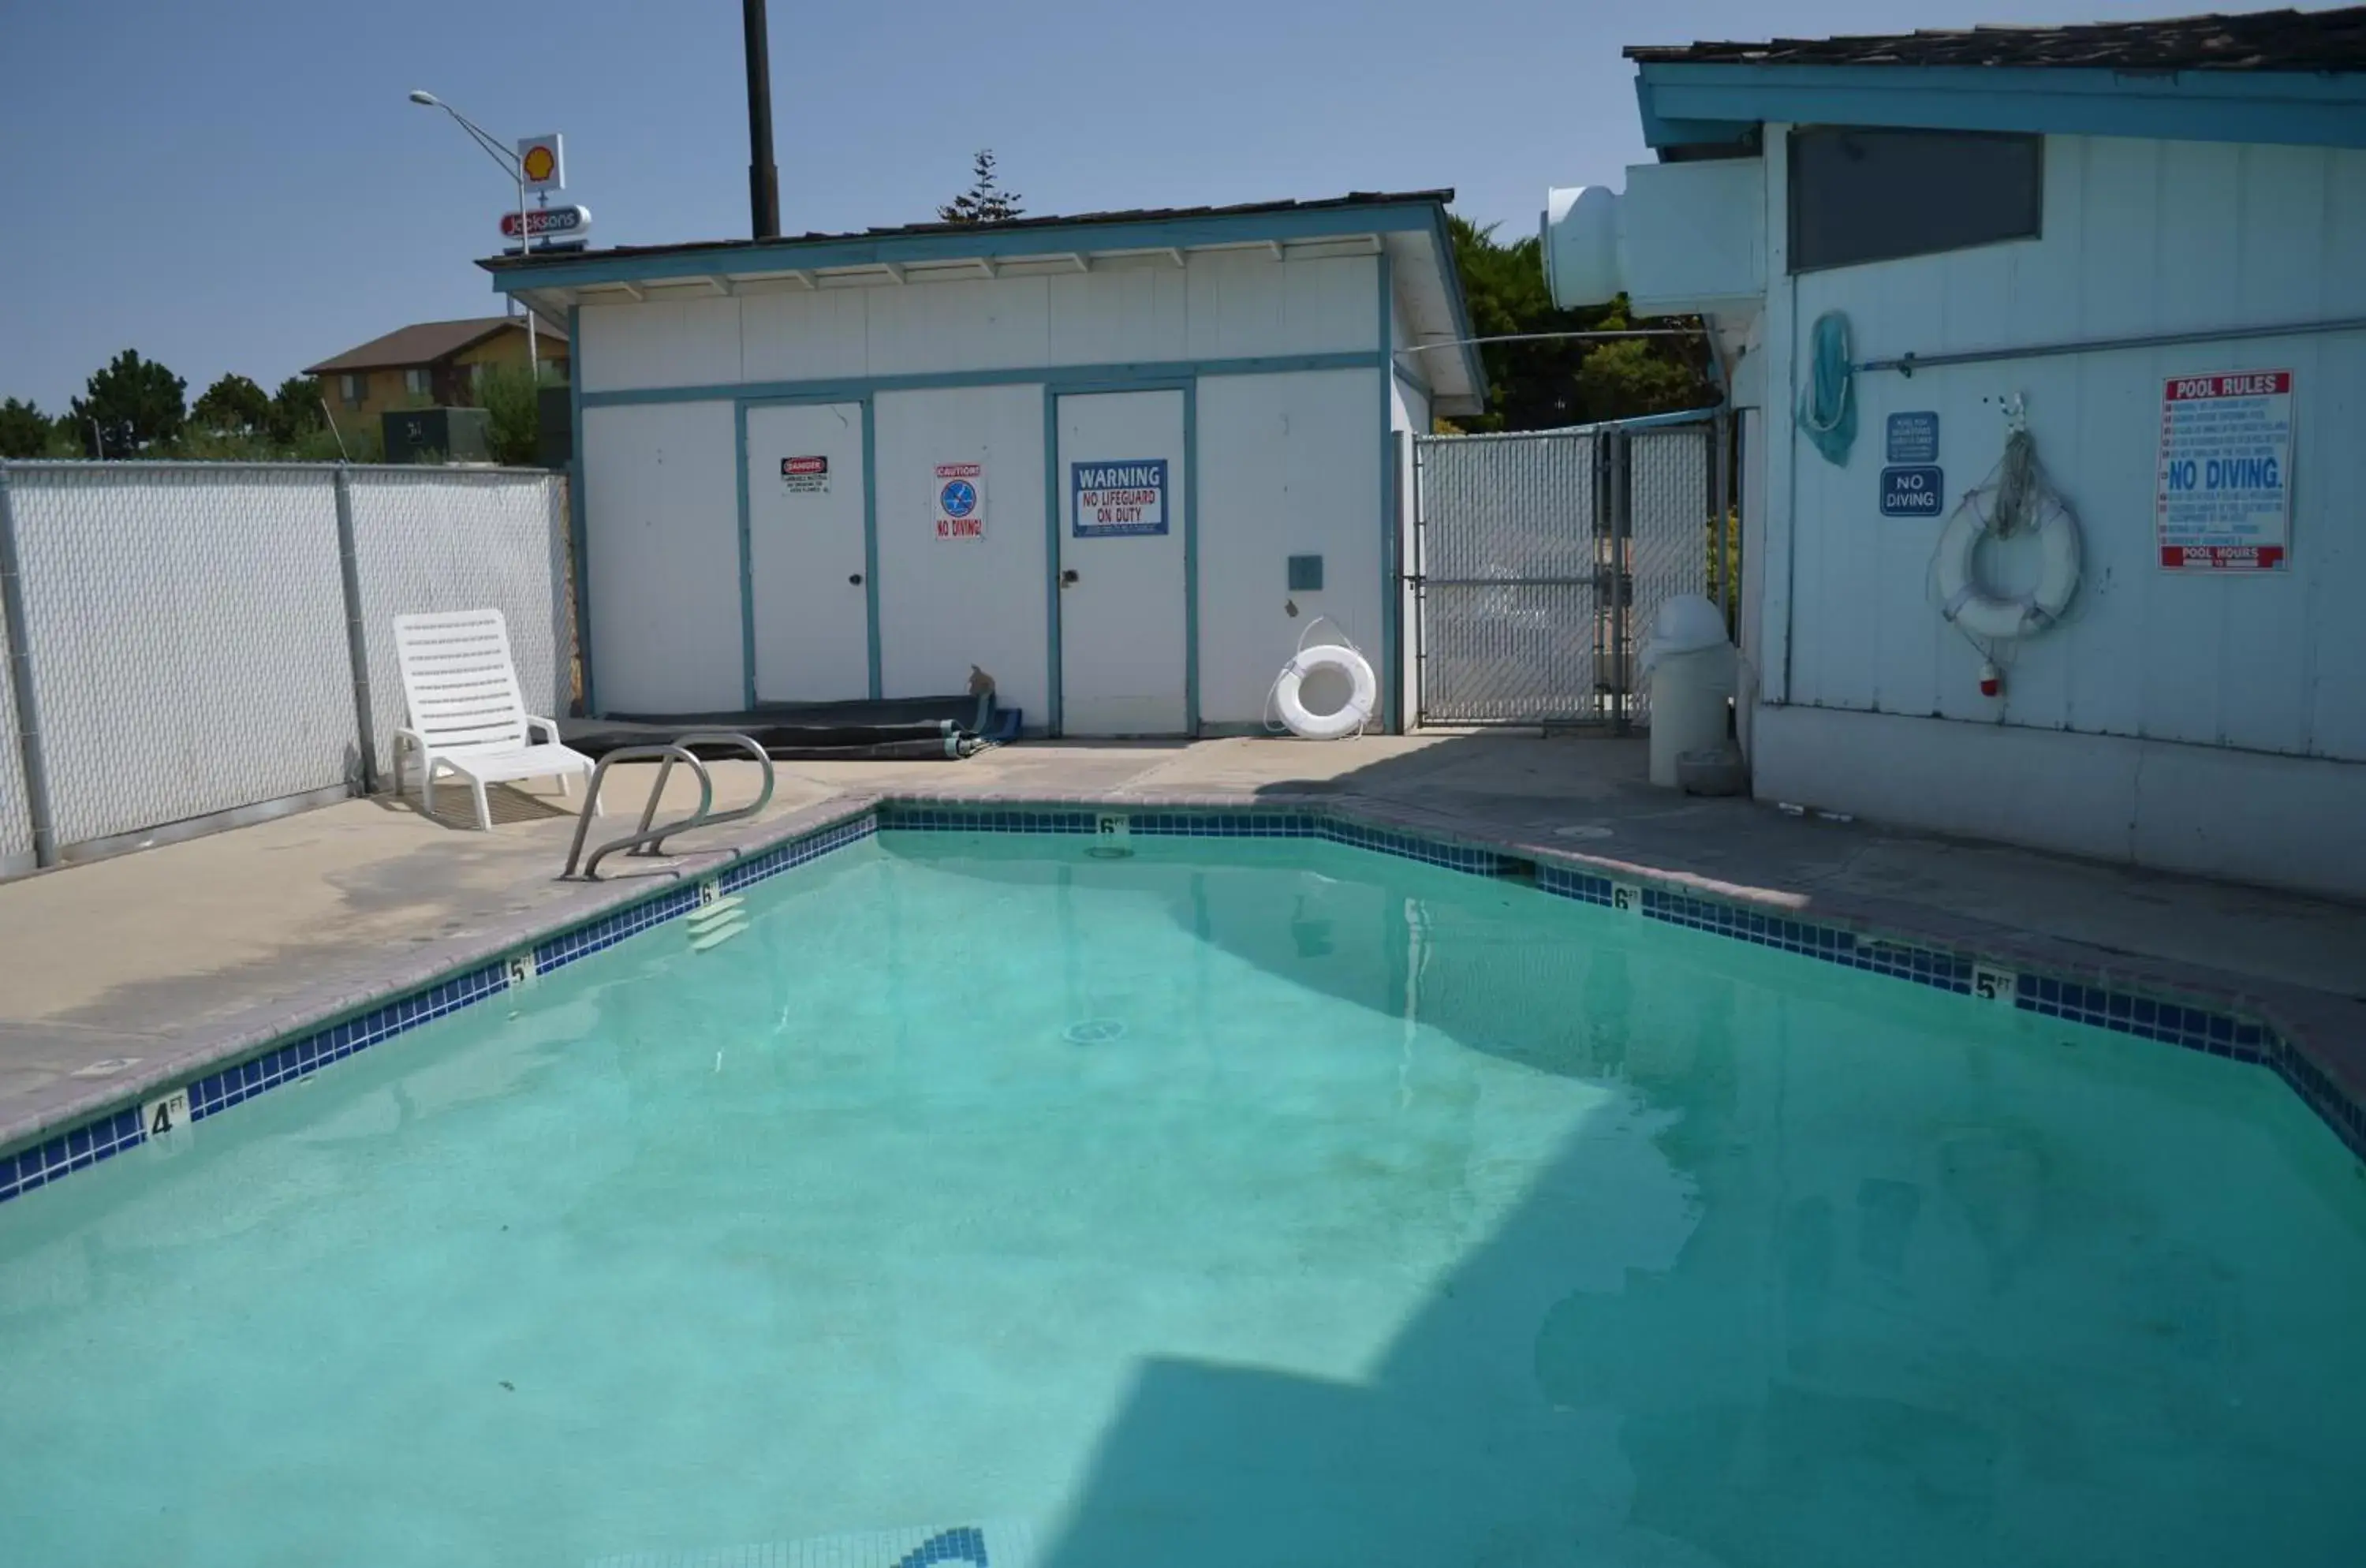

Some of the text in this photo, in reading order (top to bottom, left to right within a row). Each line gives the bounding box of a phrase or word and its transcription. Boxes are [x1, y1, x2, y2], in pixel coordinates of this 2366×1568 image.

[2176, 375, 2276, 398] POOL RULES
[1079, 466, 1160, 488] WARNING
[1897, 474, 1924, 490] NO
[2169, 457, 2283, 490] NO DIVING.
[1083, 490, 1155, 506] NO LIFEGUARD
[1886, 491, 1935, 507] DIVING
[1097, 506, 1141, 522] ON DUTY
[937, 520, 949, 536] NO
[2182, 548, 2212, 559] POOL
[1614, 888, 1629, 909] 6
[511, 958, 524, 983] 5
[1977, 972, 1995, 1000] 5
[152, 1095, 183, 1135] 4 FT
